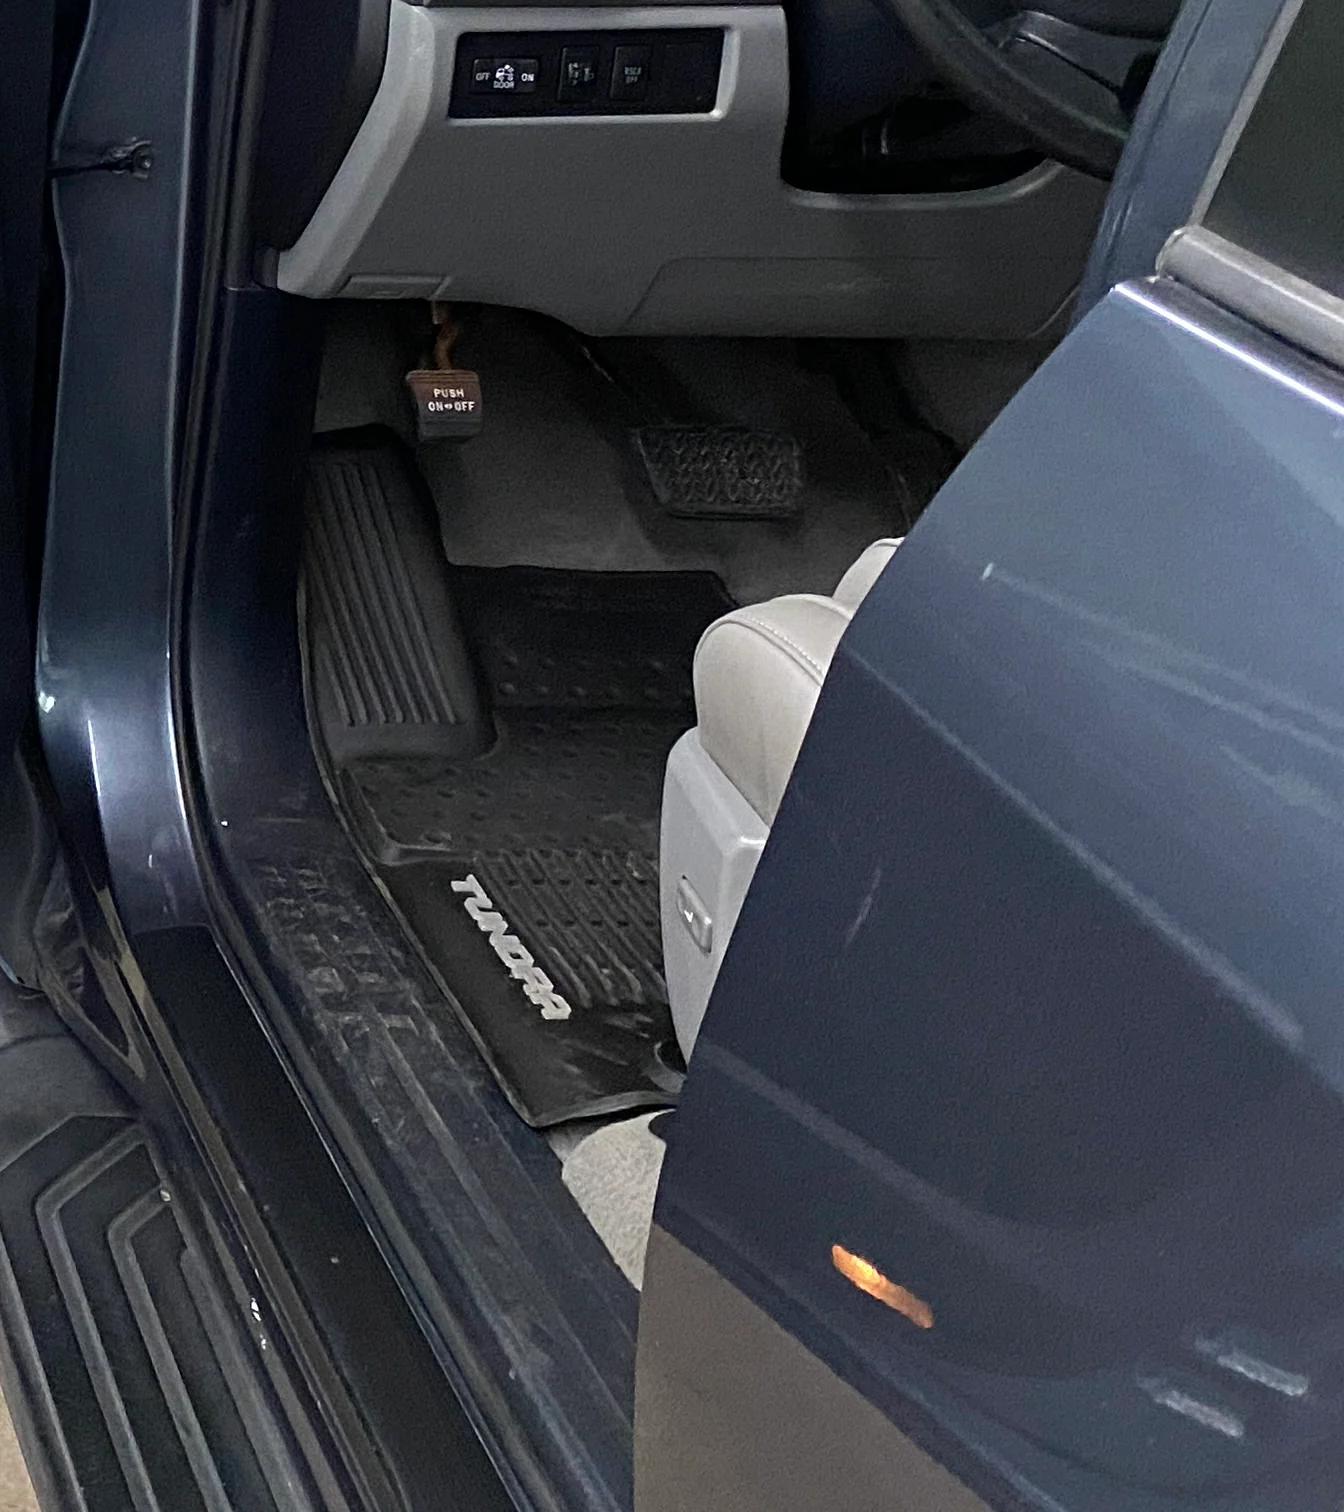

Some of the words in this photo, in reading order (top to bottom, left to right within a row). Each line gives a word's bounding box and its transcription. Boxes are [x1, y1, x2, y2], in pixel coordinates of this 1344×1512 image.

[475, 72, 491, 81] OFF
[520, 72, 535, 82] ON
[493, 80, 515, 89] DOOR
[433, 388, 465, 398] PUSH
[450, 874, 572, 1020] TUNDRA
